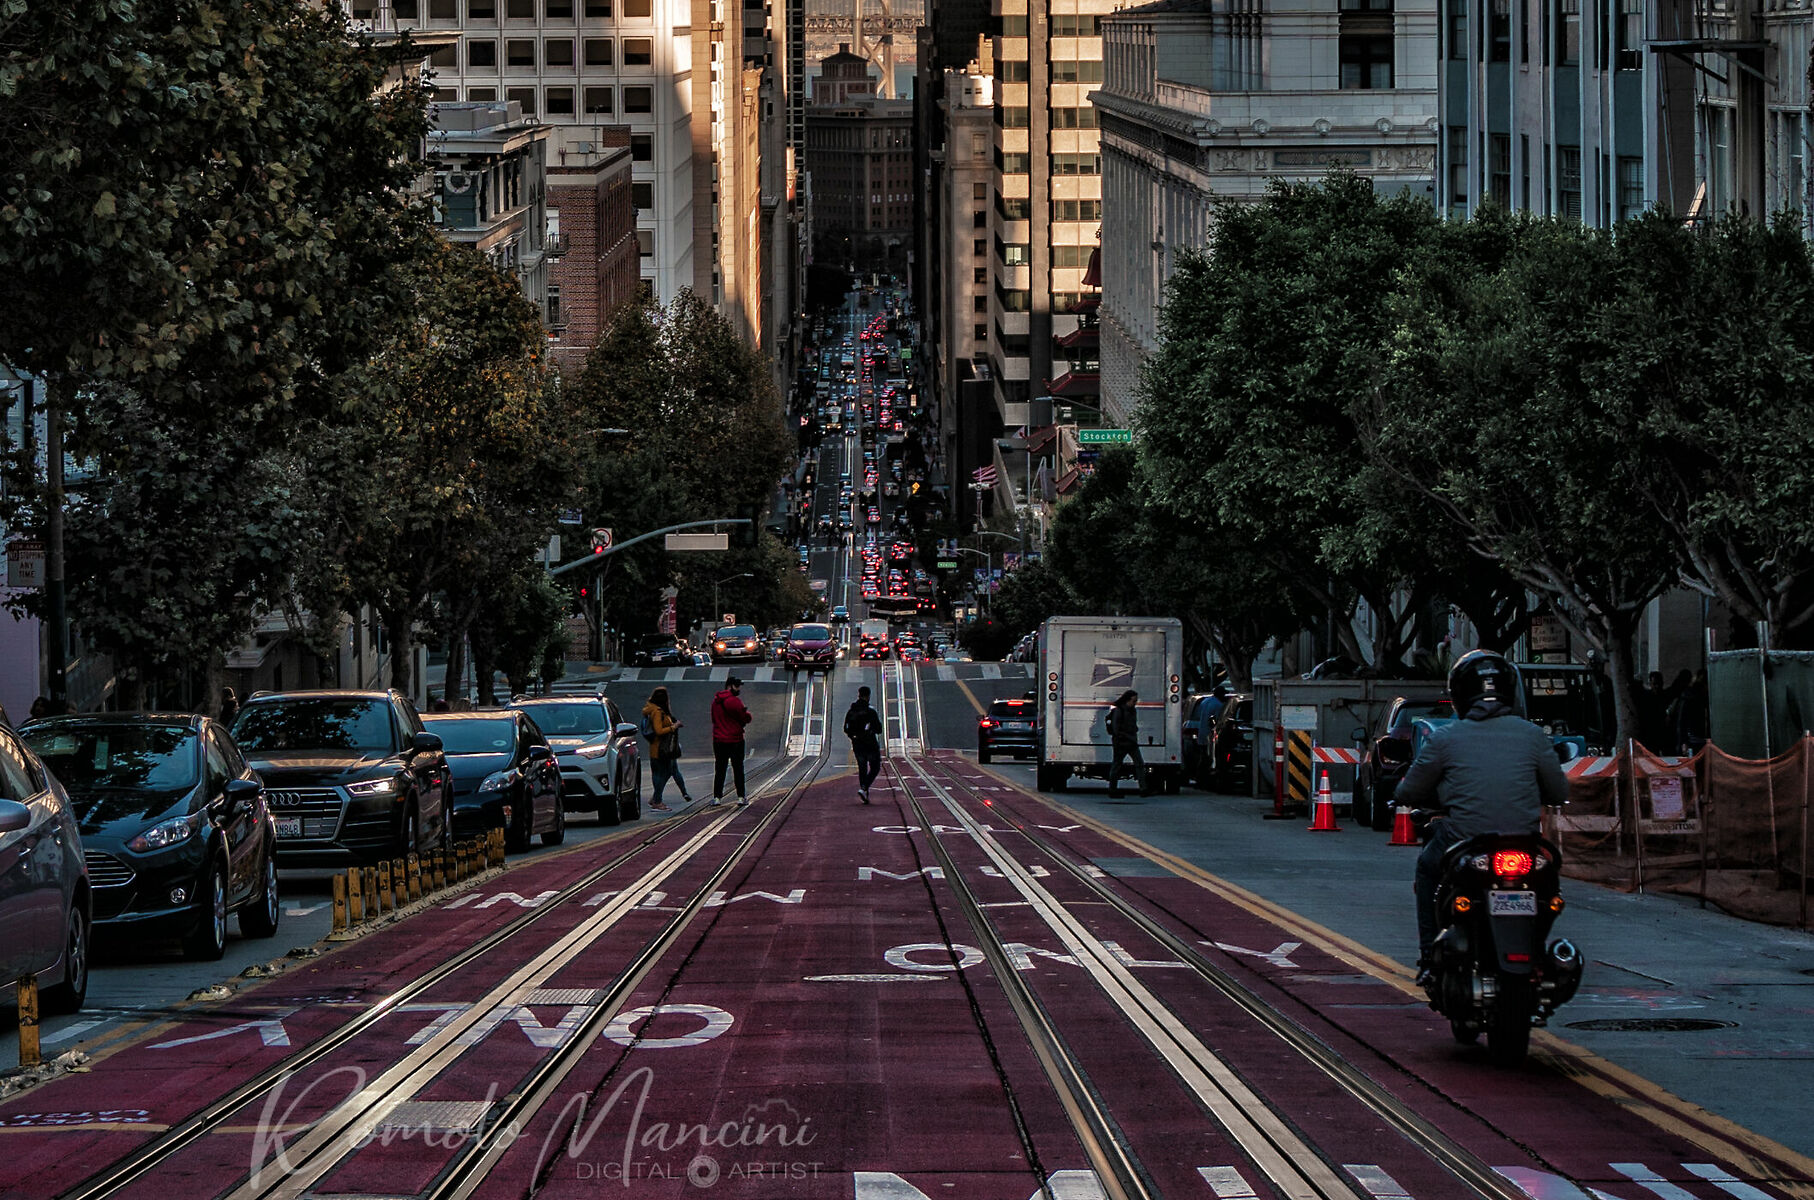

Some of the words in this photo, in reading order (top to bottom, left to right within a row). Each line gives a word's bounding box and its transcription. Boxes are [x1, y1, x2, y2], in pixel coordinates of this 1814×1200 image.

[8, 551, 19, 560] NO
[872, 824, 1083, 834] ONLY
[441, 888, 807, 911] MUNI
[884, 941, 1301, 971] ONLY
[146, 1003, 734, 1049] ONLY
